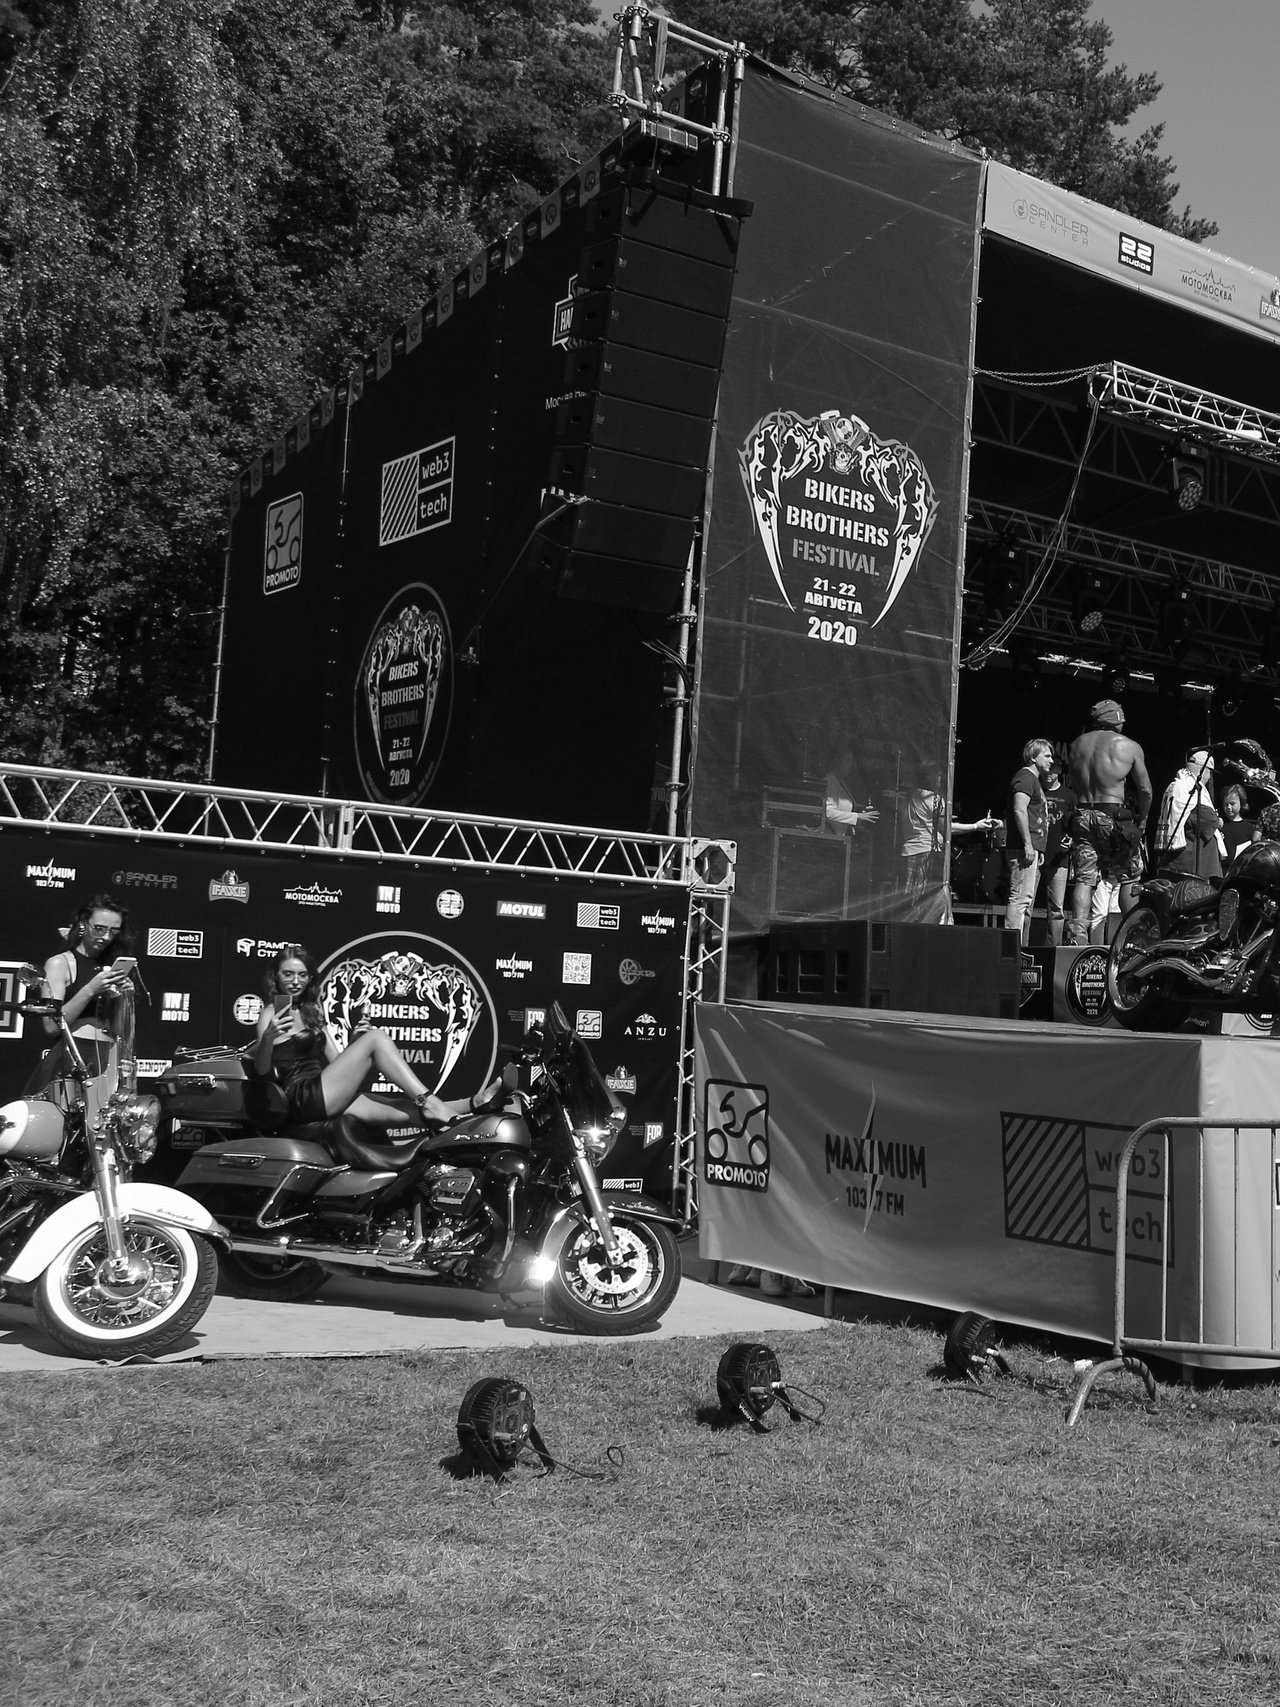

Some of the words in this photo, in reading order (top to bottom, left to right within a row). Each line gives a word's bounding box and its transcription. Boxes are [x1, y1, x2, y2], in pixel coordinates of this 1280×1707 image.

[1029, 203, 1089, 237] SANDLER
[1028, 216, 1089, 246] CENTER
[1121, 236, 1152, 263] 22
[1120, 254, 1151, 272] studios
[1181, 274, 1233, 302] МОТОМОСКВА
[422, 451, 450, 479] web3
[804, 477, 876, 514] BIKERS
[420, 492, 447, 519] tech
[786, 504, 889, 548] BROTHERS
[792, 537, 880, 577] FESTIVAL
[265, 565, 299, 588] PROMOTO
[804, 591, 863, 616] АВГУСТА
[807, 615, 858, 646] 2020
[388, 660, 419, 681] BIKERS
[381, 684, 425, 707] BROTHERS
[383, 709, 420, 731] FESTIVAL
[388, 748, 413, 761] АВГУСТА
[389, 768, 411, 787] 2020
[26, 863, 77, 882] MAXIMUM
[126, 871, 178, 883] SANDLER
[125, 880, 178, 889] CENTER
[211, 884, 247, 898] FAXE
[377, 885, 395, 902] IN
[284, 892, 340, 904] МОТОМОСКВА
[376, 901, 401, 914] MOTO
[499, 902, 545, 918] MOTUL
[600, 907, 618, 916] web3
[600, 918, 617, 926] tech
[641, 914, 676, 929] MAXIMUM
[178, 934, 200, 943] web3
[177, 946, 199, 954] tech
[495, 958, 533, 973] MAXIMUM
[163, 992, 182, 1009] IN
[161, 1010, 190, 1022] MOTO
[370, 1003, 430, 1021] BIKERS
[624, 1026, 668, 1037] ANZU
[607, 1078, 635, 1091] FAXE
[646, 1124, 662, 1144] FOR
[824, 1132, 927, 1189] MAXIMUM
[624, 1181, 641, 1189] web3
[706, 1163, 767, 1188] PROMOTO
[885, 1191, 905, 1216] FM
[1098, 1206, 1162, 1243] tch
